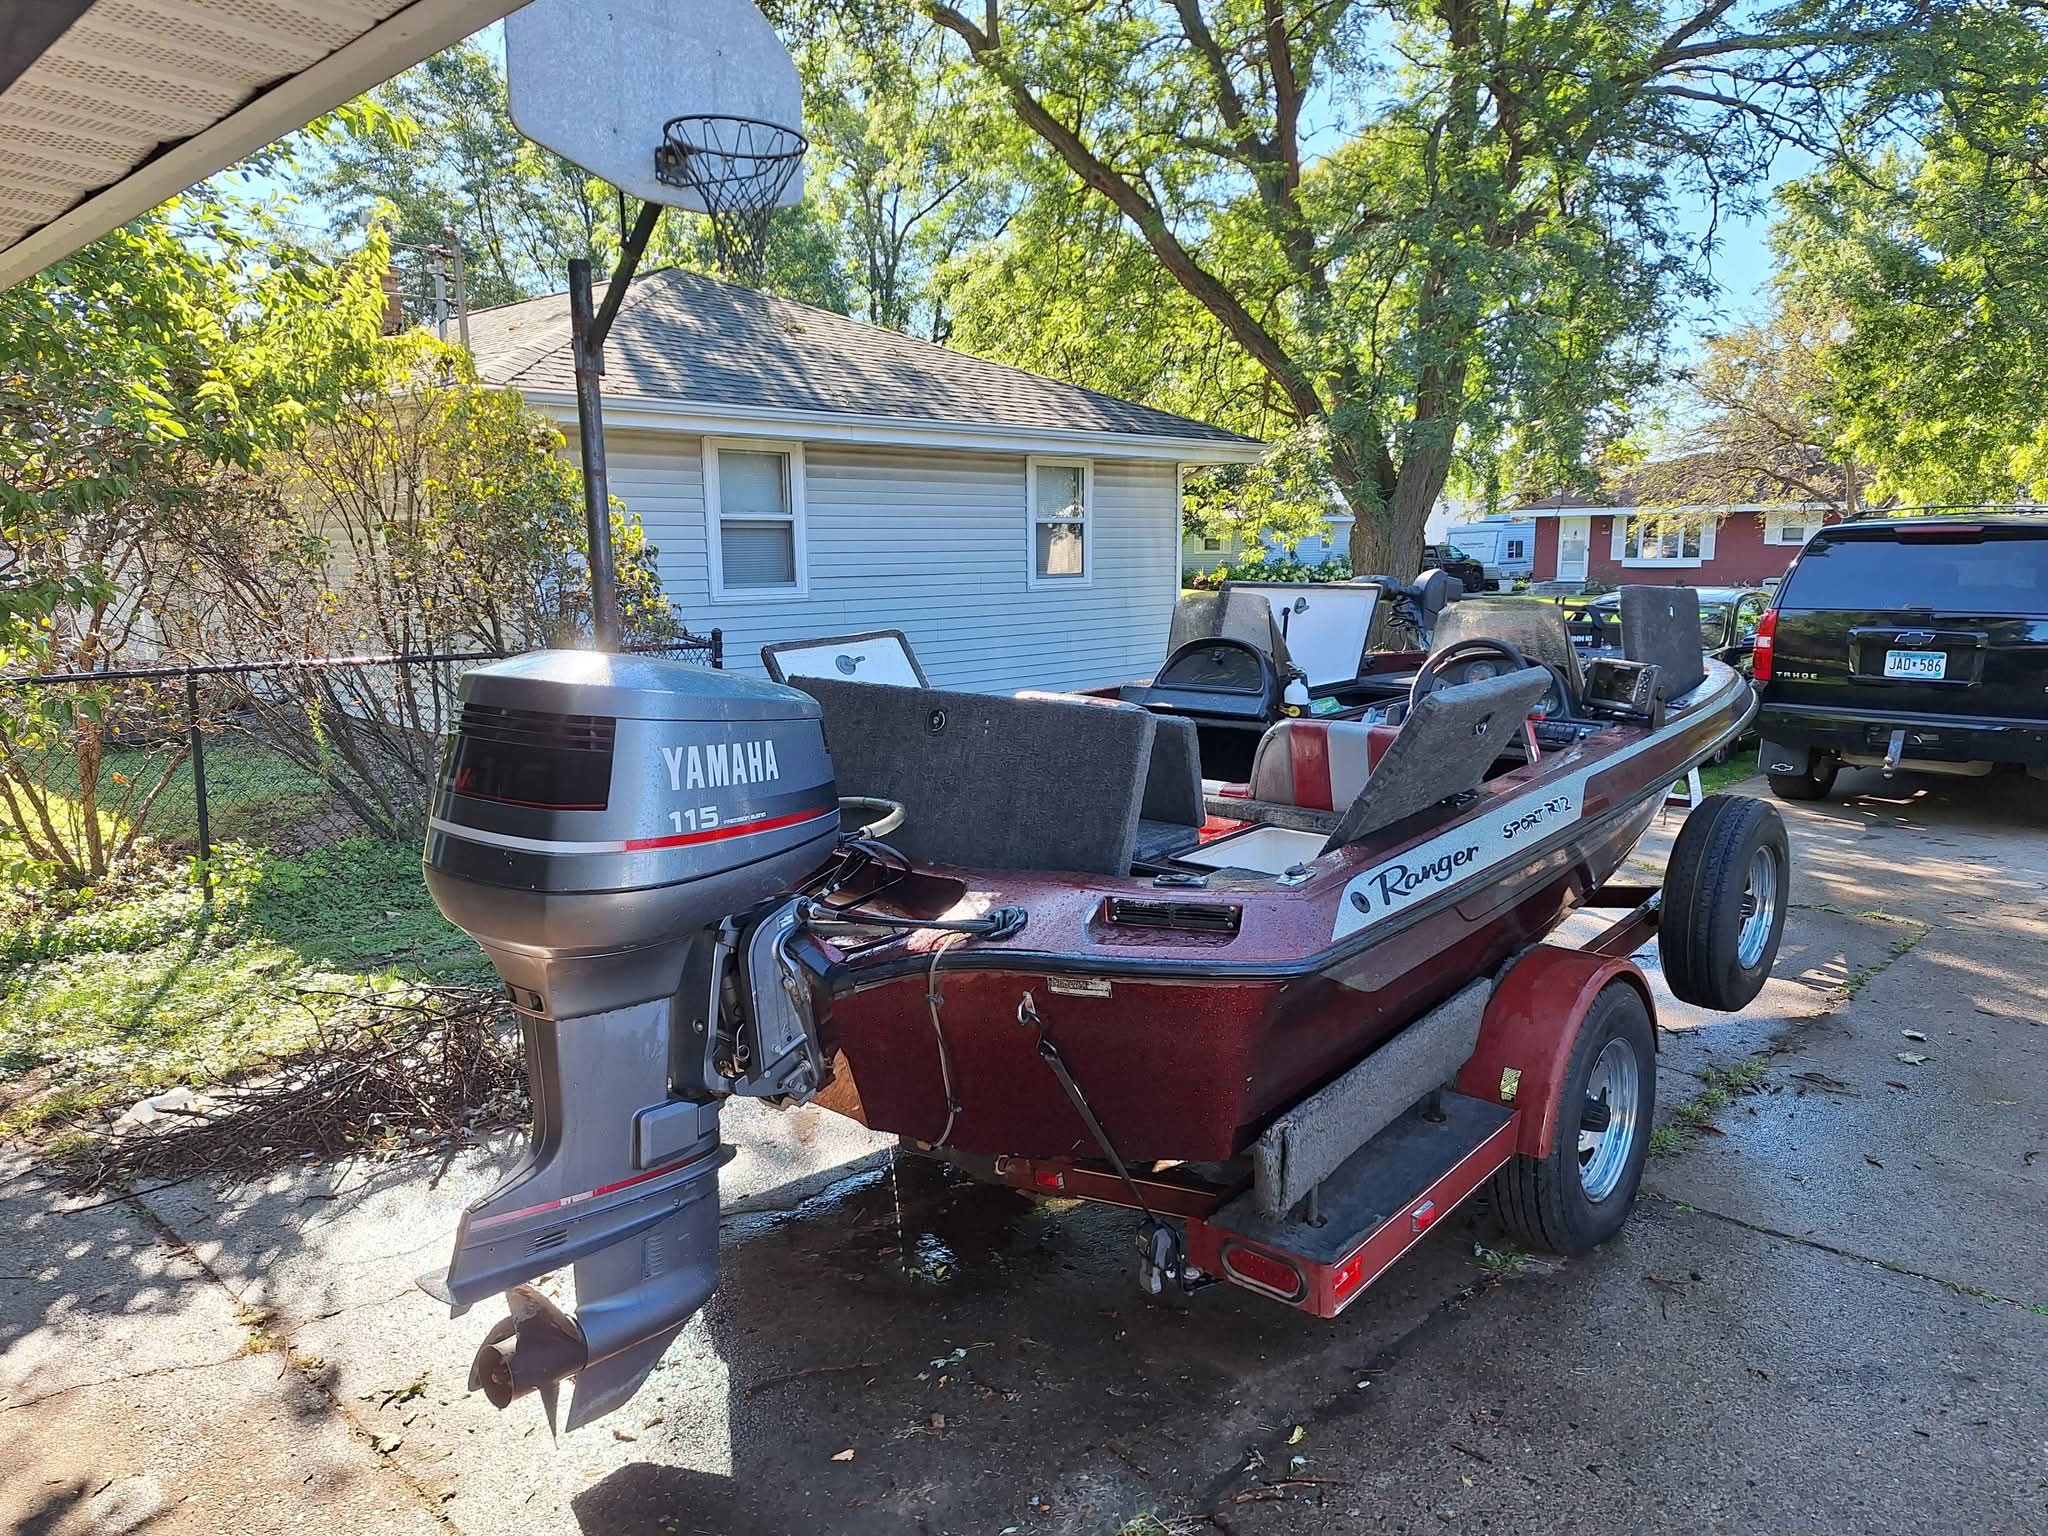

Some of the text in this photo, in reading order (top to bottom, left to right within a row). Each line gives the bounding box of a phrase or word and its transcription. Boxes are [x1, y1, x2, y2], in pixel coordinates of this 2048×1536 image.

[1775, 671, 1818, 680] TAHOE
[663, 739, 780, 790] YAMAHA
[668, 805, 719, 832] 115
[1502, 808, 1543, 839] SPORT
[1368, 846, 1479, 905] Ranger
